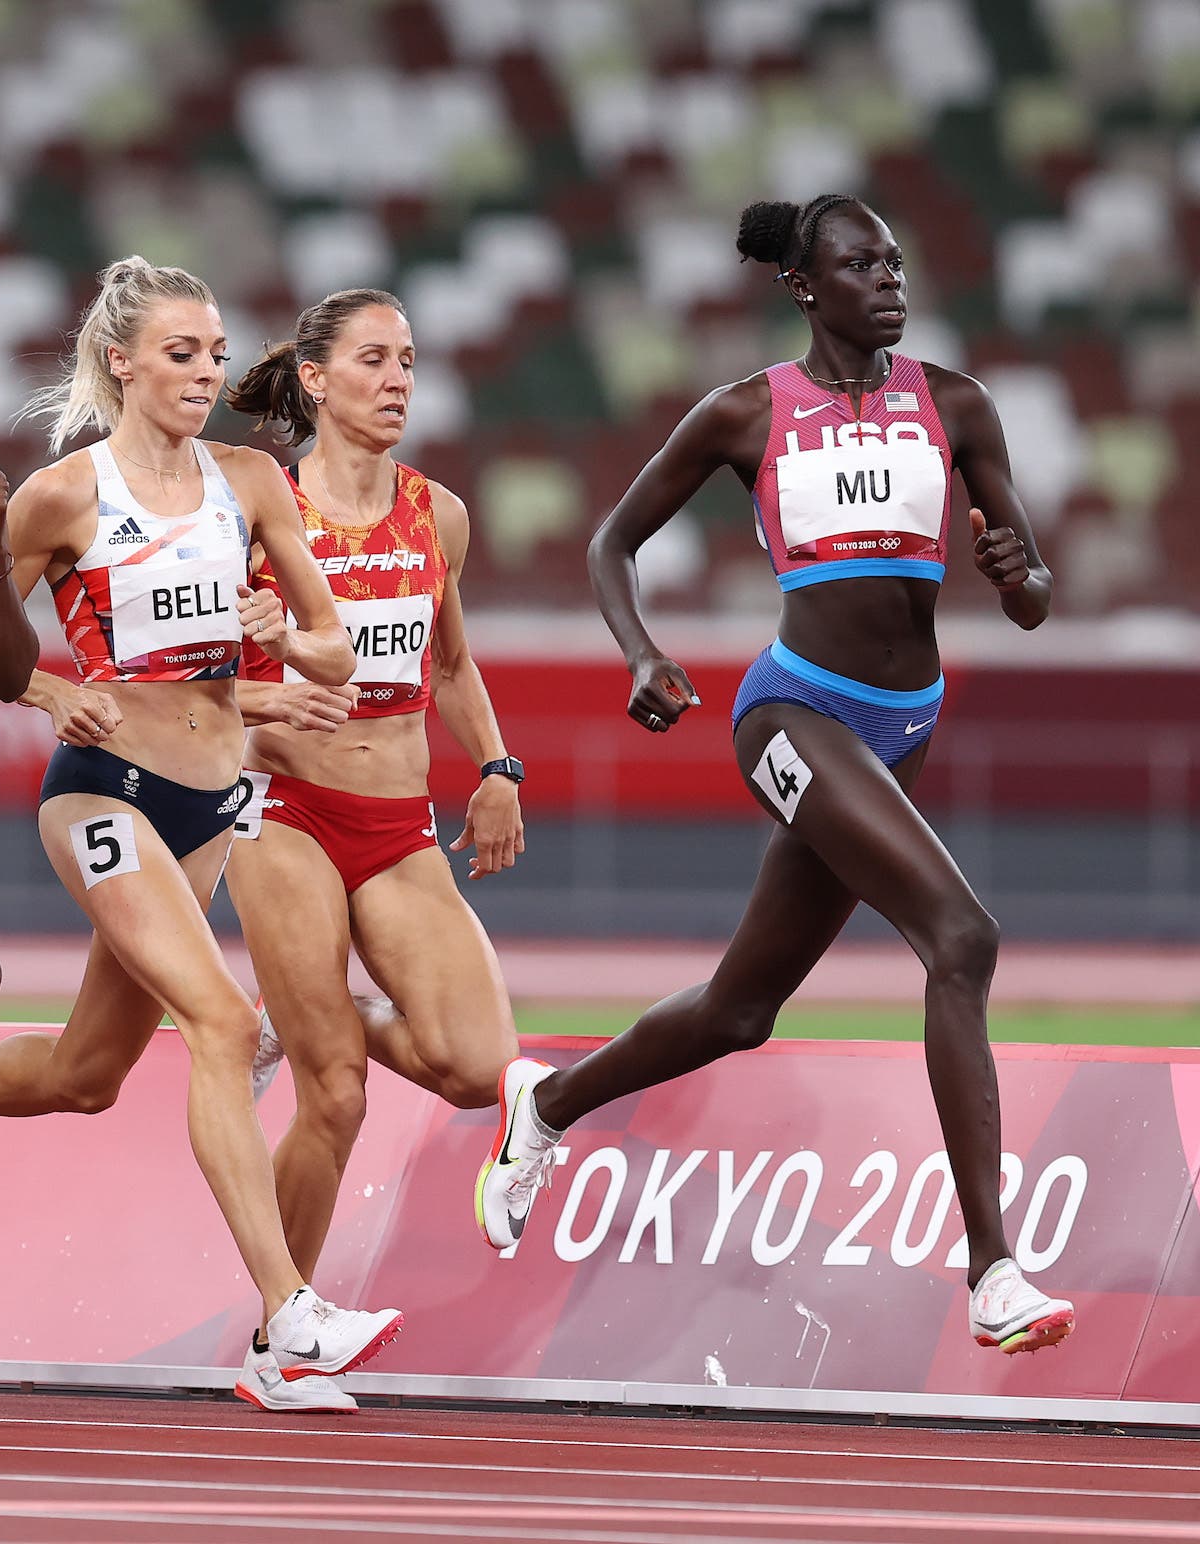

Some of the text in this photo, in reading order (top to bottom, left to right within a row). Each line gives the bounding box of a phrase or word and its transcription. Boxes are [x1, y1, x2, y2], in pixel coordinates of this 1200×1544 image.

[836, 468, 891, 505] MU
[108, 534, 150, 545] adidas
[832, 540, 877, 551] TOKYO 2020
[153, 581, 229, 621] BELL
[164, 652, 205, 663] TOKYO 2020
[766, 751, 799, 802] 4
[85, 819, 122, 875] 5
